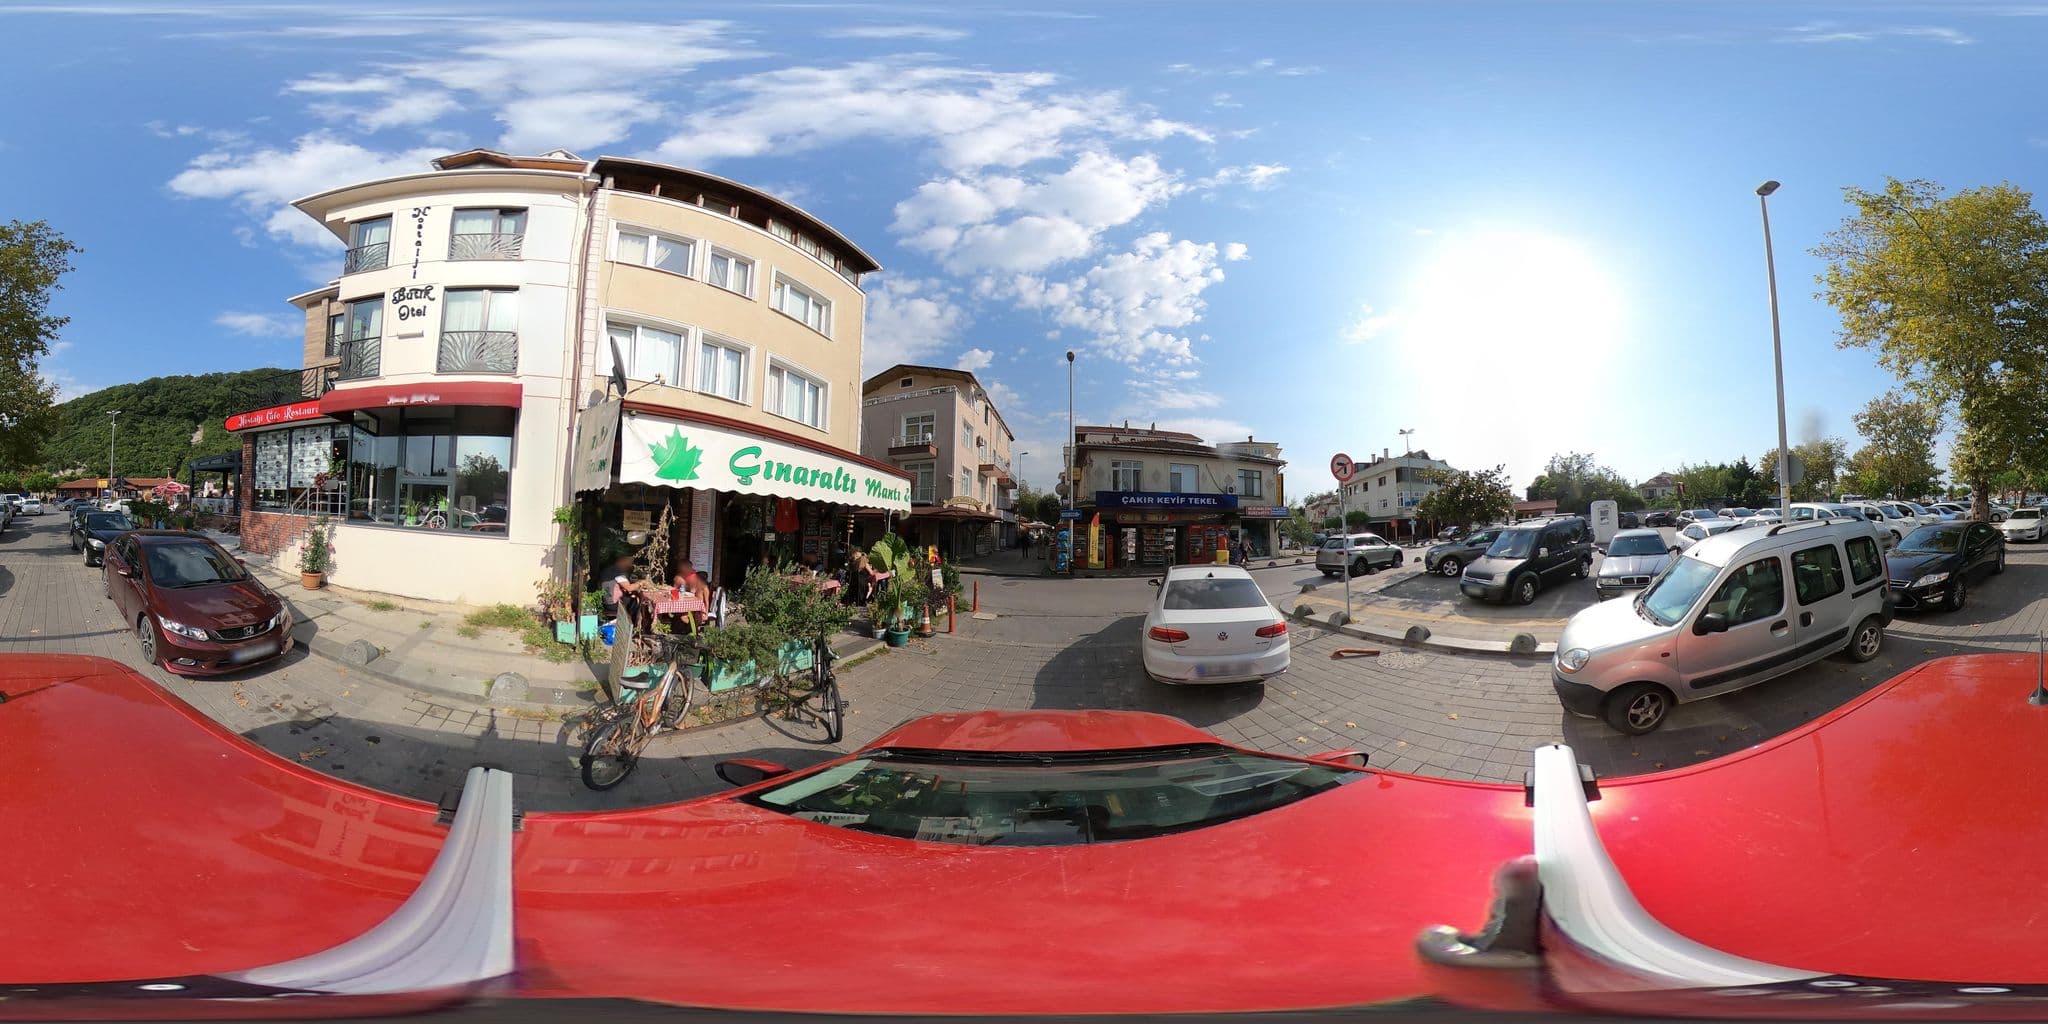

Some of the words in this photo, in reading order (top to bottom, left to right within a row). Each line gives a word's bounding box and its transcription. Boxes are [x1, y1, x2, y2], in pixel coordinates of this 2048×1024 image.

[391, 285, 436, 305] Butik
[398, 305, 427, 321] Otel
[729, 445, 857, 494] Çınaraltı
[864, 477, 901, 502] Mantı
[1121, 496, 1154, 505] ÇAKIR
[1157, 496, 1186, 504] KEYİF
[1188, 497, 1218, 505] TEKEL
